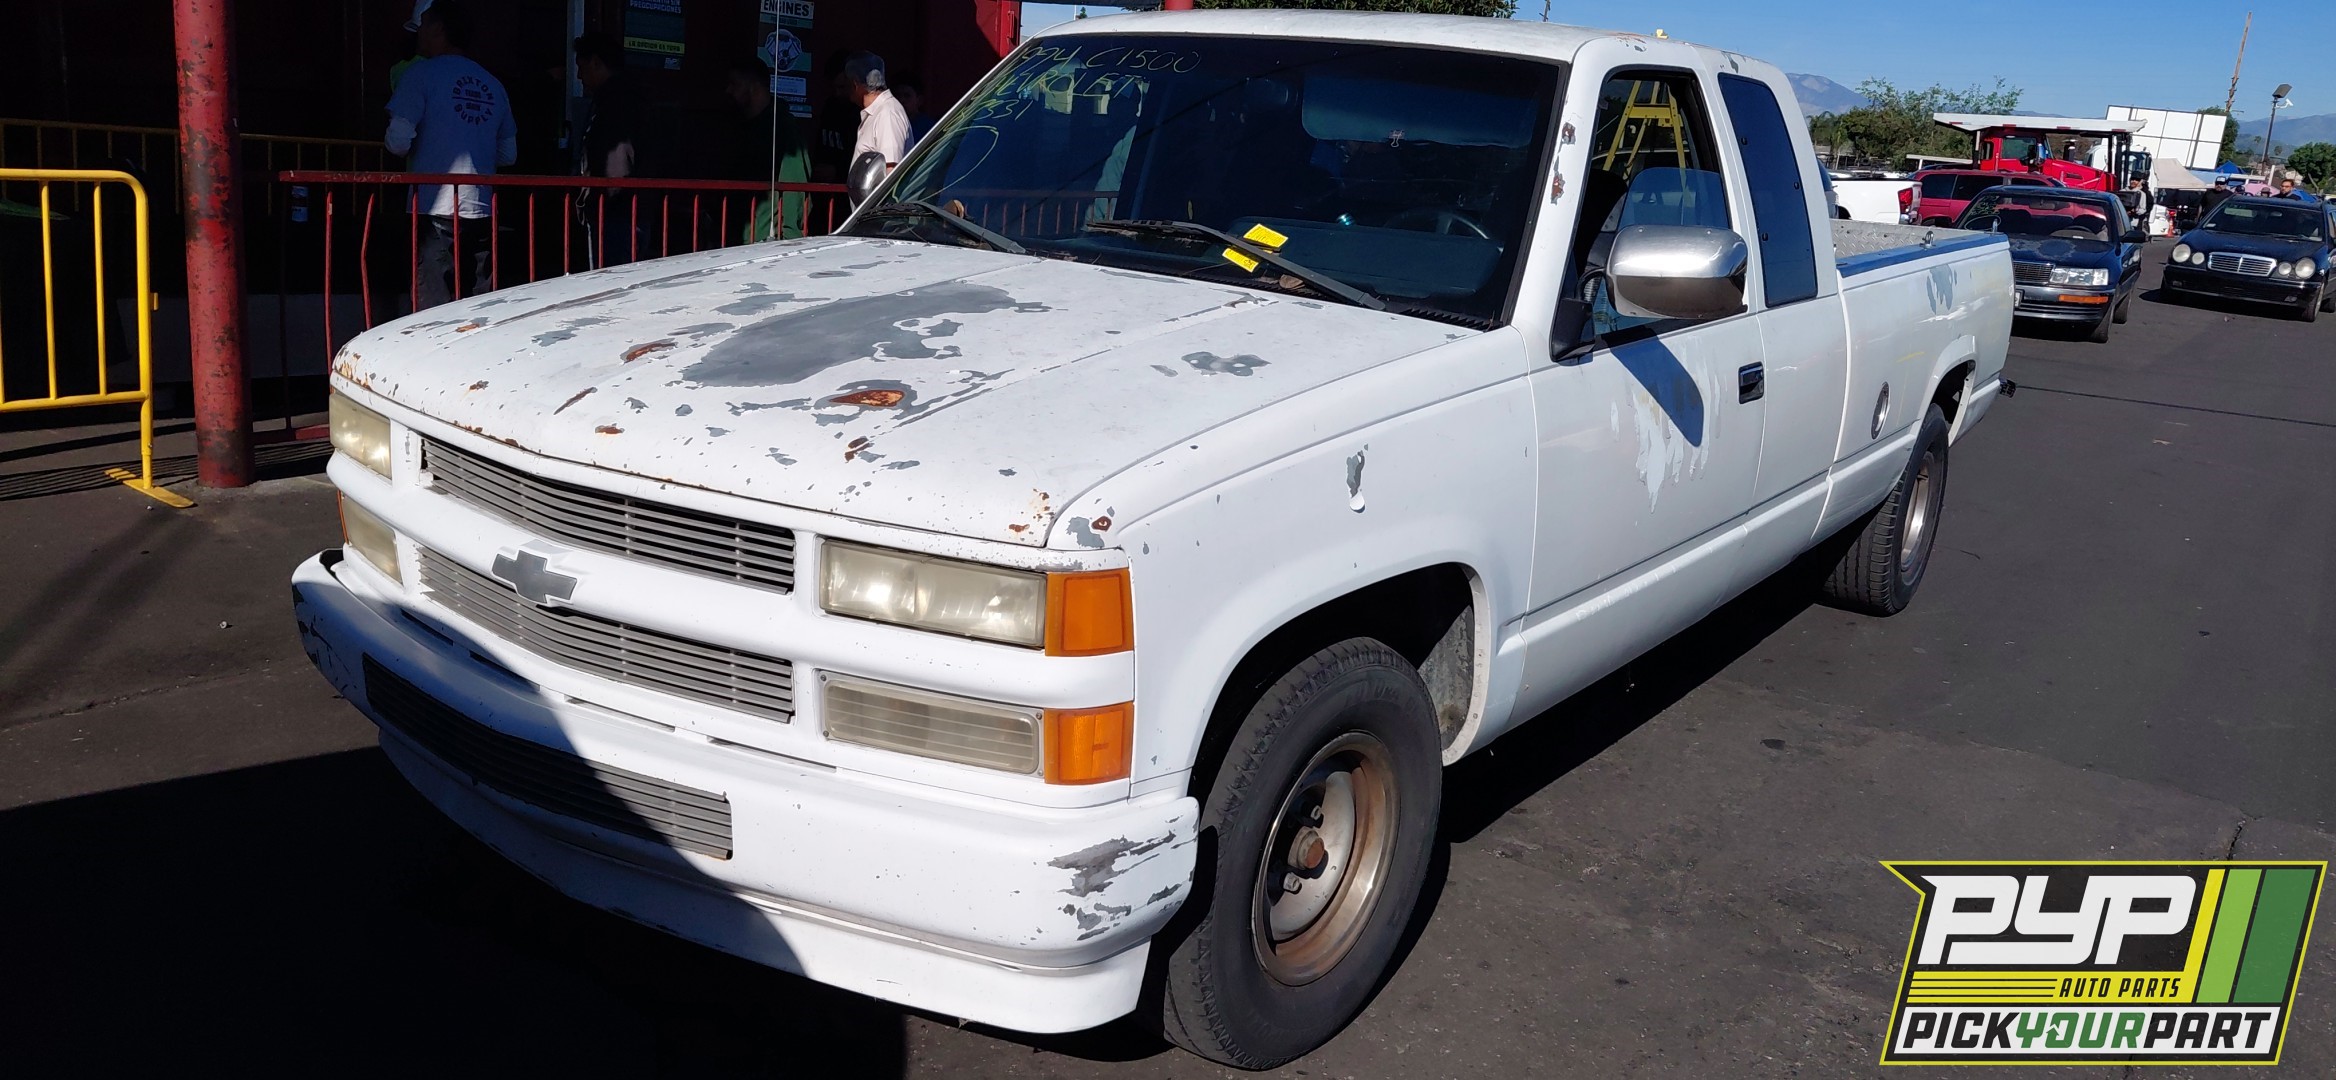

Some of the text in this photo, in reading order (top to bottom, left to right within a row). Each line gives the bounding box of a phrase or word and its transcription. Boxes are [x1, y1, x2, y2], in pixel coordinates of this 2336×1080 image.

[763, 0, 809, 16] ENGINES
[1085, 46, 1202, 73] C1500
[452, 75, 494, 100] BRIXTON
[453, 103, 493, 126] SUPPLY
